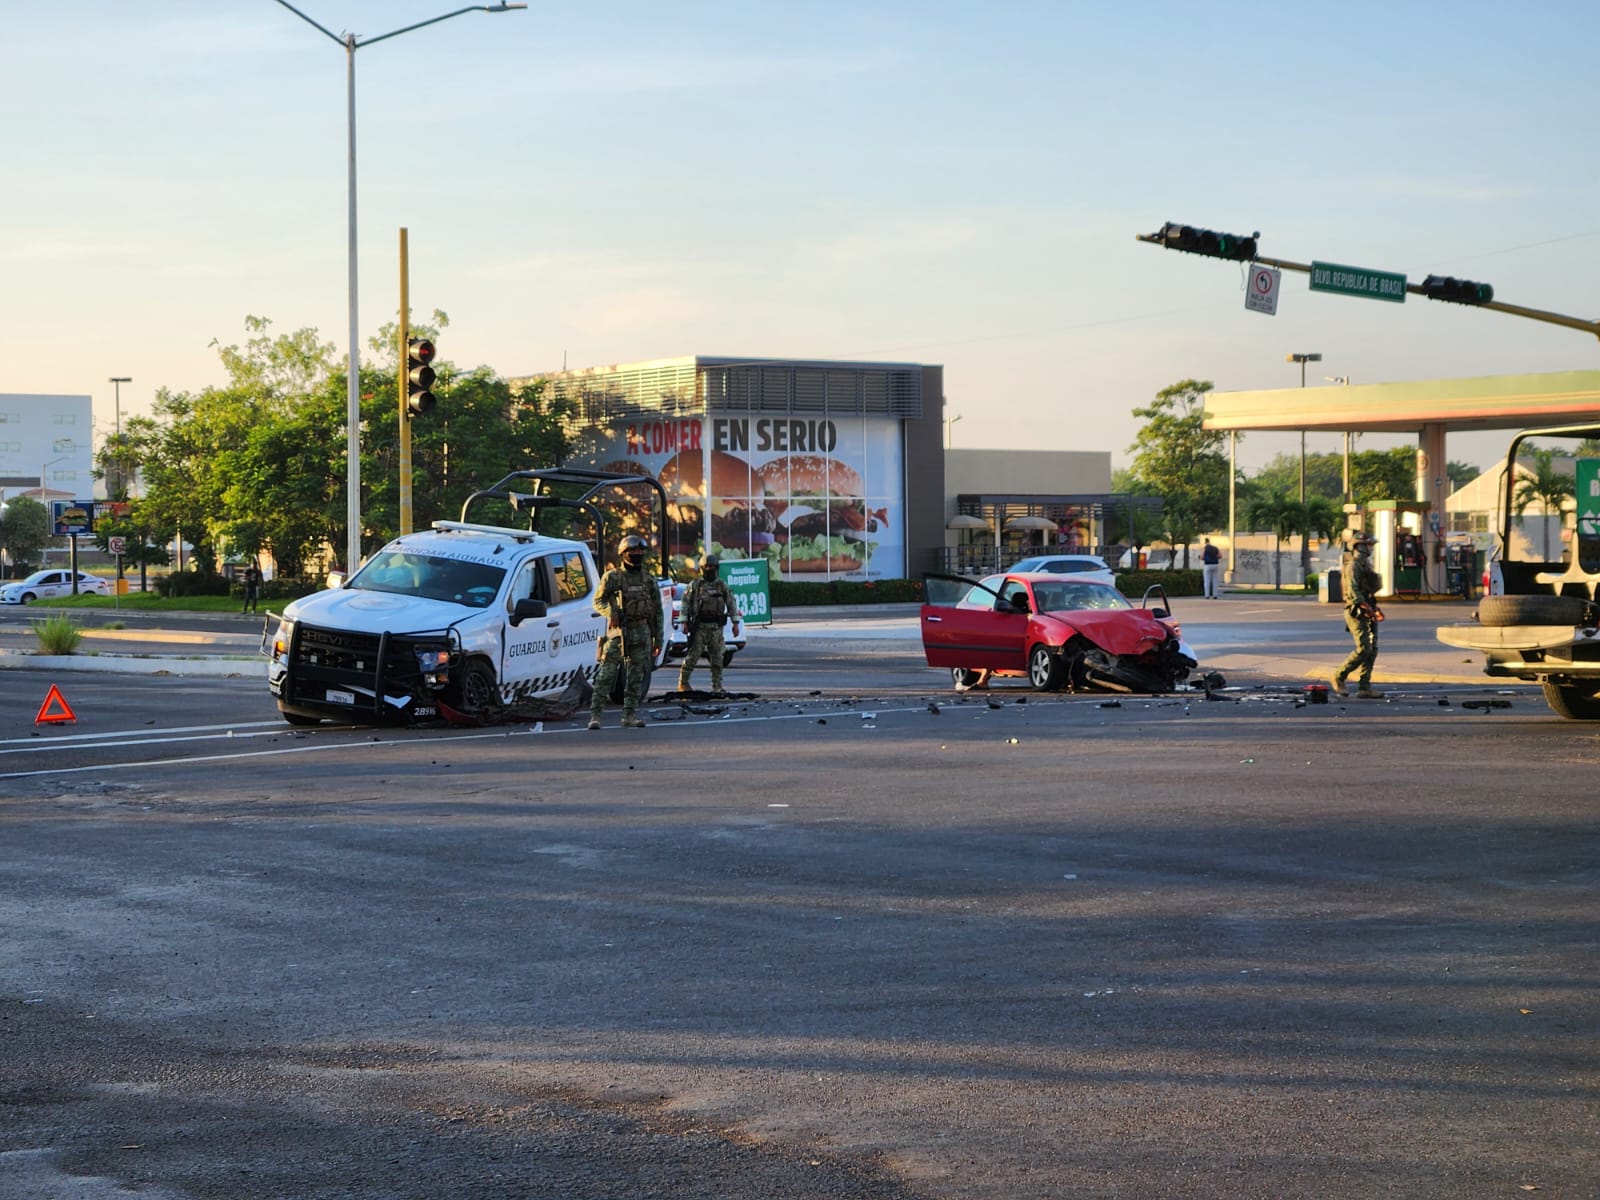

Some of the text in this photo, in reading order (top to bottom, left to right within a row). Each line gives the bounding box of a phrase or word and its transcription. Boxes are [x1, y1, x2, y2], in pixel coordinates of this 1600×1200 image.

[1314, 269, 1403, 296] BLVD. REPUBLICA DE BRASIL
[626, 418, 837, 456] A COMER EN SERIO
[727, 574, 760, 586] Regular
[509, 640, 547, 658] GUARDIA
